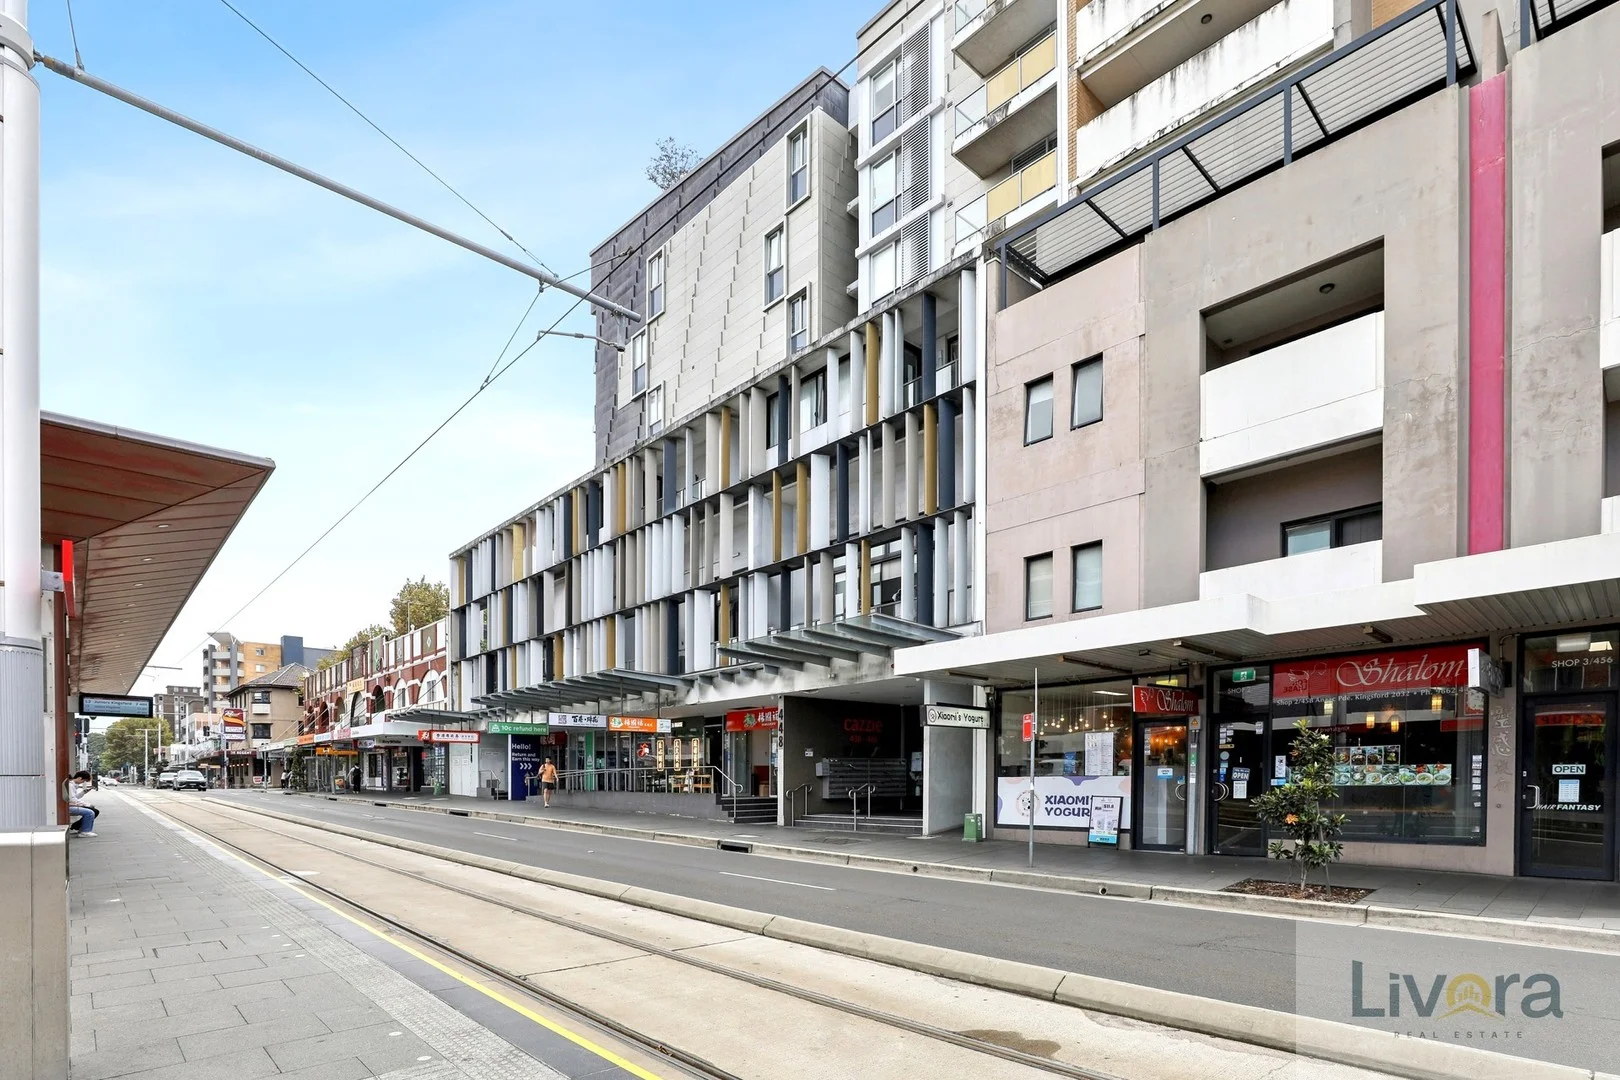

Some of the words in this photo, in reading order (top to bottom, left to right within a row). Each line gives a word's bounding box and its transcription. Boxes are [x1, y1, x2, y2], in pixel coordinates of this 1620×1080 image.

[1551, 658, 1580, 668] SHOP
[1583, 656, 1613, 666] 3/456
[1335, 654, 1465, 687] Shalom
[1157, 689, 1194, 711] Shalom
[1355, 692, 1389, 700] Kingsford
[937, 711, 961, 721] Xiaomi's
[963, 713, 984, 723] Yogurt
[1554, 765, 1584, 773] OPEN
[1044, 807, 1090, 817] YOGUR
